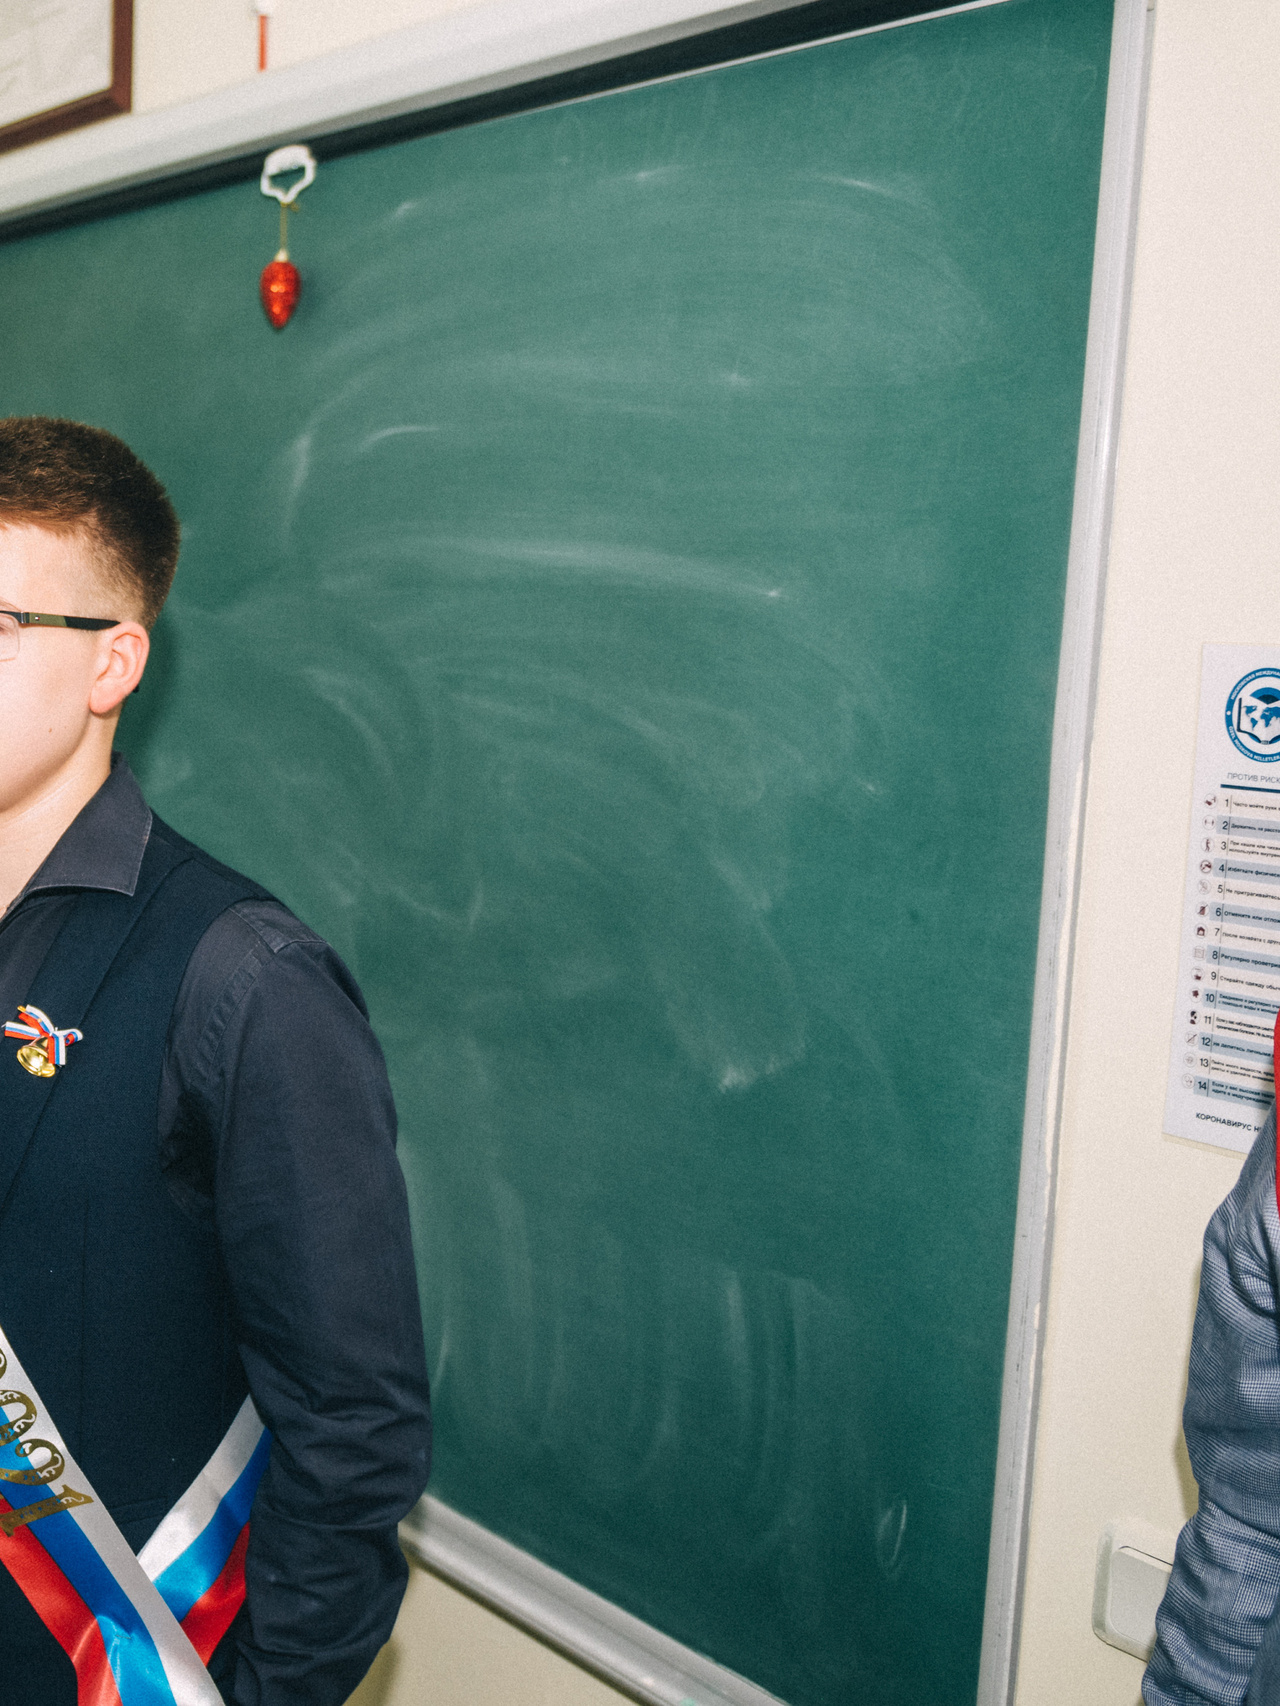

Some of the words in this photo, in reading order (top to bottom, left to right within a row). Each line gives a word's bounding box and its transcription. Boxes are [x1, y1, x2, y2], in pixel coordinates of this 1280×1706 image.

[1227, 772, 1258, 782] ПРОТИВ
[1225, 799, 1229, 807] 1
[1222, 821, 1228, 830] 2
[1221, 842, 1226, 850] 3
[1219, 864, 1224, 872] 4
[1218, 884, 1223, 893] 5
[1216, 908, 1222, 916] 6
[1215, 928, 1220, 936] 7
[1212, 951, 1218, 959] 8
[1211, 972, 1216, 980] 9
[1206, 993, 1214, 1002] 10
[1204, 1016, 1211, 1024] 11
[1201, 1037, 1211, 1046] 12
[1200, 1058, 1209, 1068] 13
[1197, 1081, 1206, 1090] 14
[1196, 1112, 1252, 1131] КОРОНАВИРУС
